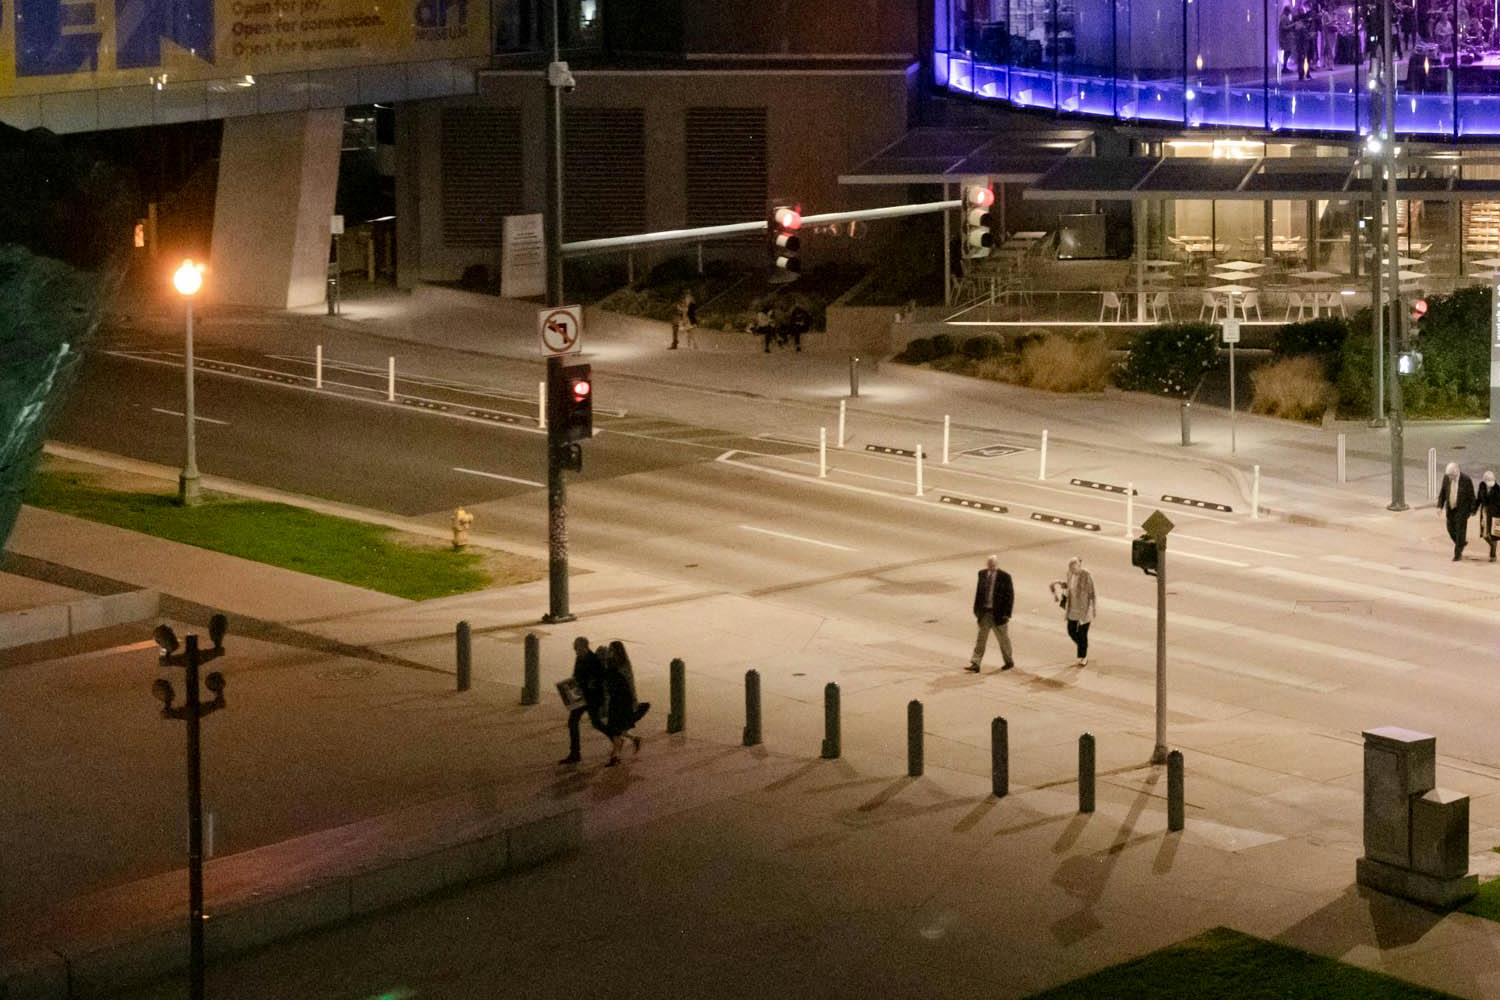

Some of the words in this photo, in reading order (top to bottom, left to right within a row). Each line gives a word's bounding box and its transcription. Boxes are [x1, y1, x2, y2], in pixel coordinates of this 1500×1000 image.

[232, 0, 272, 19] Open
[231, 21, 272, 41] Open
[274, 17, 297, 34] for
[300, 12, 385, 33] connection.
[232, 41, 272, 60] Open
[274, 37, 297, 53] for
